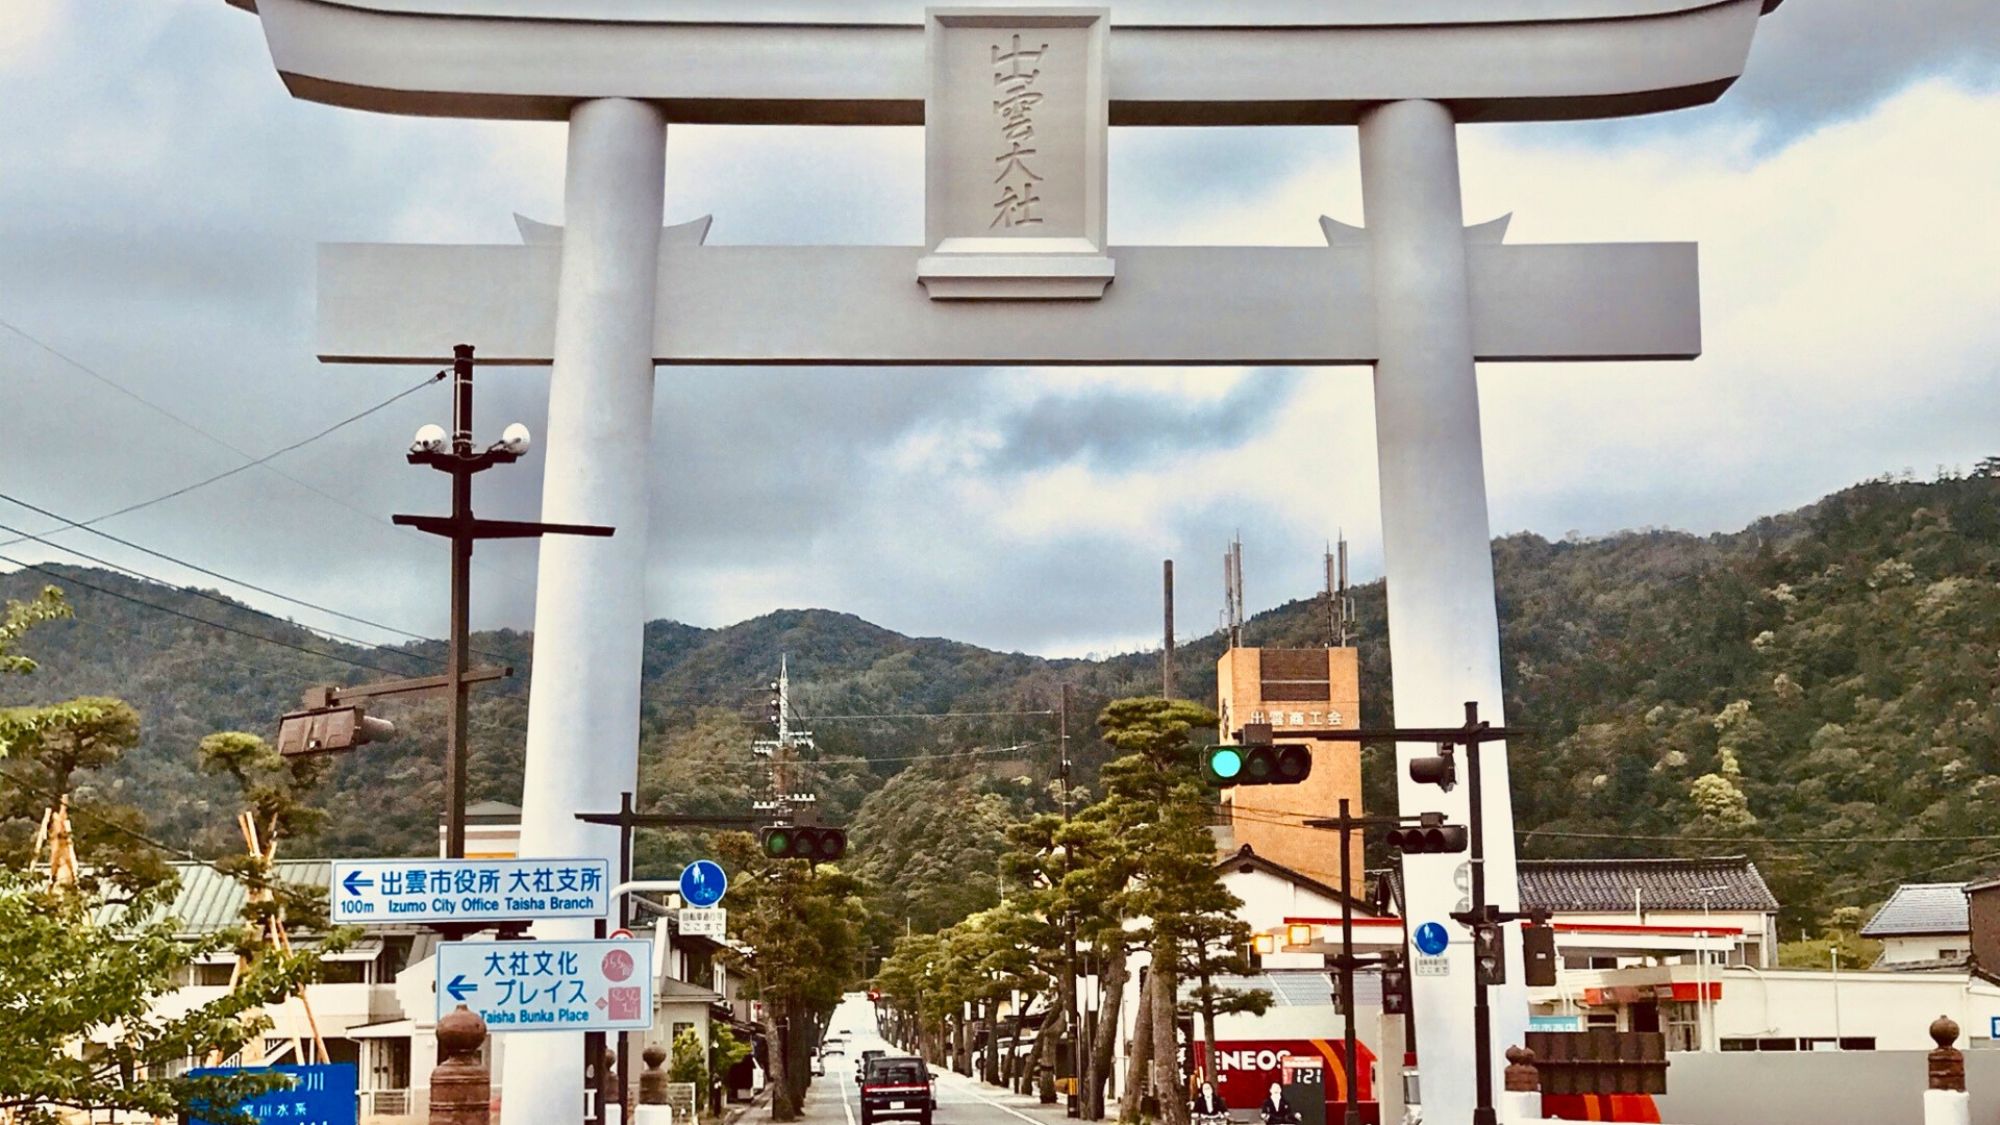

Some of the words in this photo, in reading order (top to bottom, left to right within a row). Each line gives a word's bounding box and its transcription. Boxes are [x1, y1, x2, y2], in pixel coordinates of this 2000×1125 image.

[990, 34, 1048, 228] 出雲大社
[1250, 711, 1342, 726] 出雲商工会
[381, 869, 500, 895] 出雲市役所
[508, 867, 602, 893] 大社支所
[340, 899, 374, 913] 100m
[388, 900, 427, 913] Izumo
[432, 898, 456, 914] City
[461, 897, 499, 911] Office
[505, 897, 546, 911] Taisha
[550, 896, 594, 910] Branch
[484, 950, 578, 976] 大社文化
[495, 979, 588, 1006] プレイス
[480, 1010, 515, 1024] Taisha
[519, 1008, 554, 1022] Bunka
[558, 1007, 590, 1022] Place
[1296, 1068, 1321, 1084] 121
